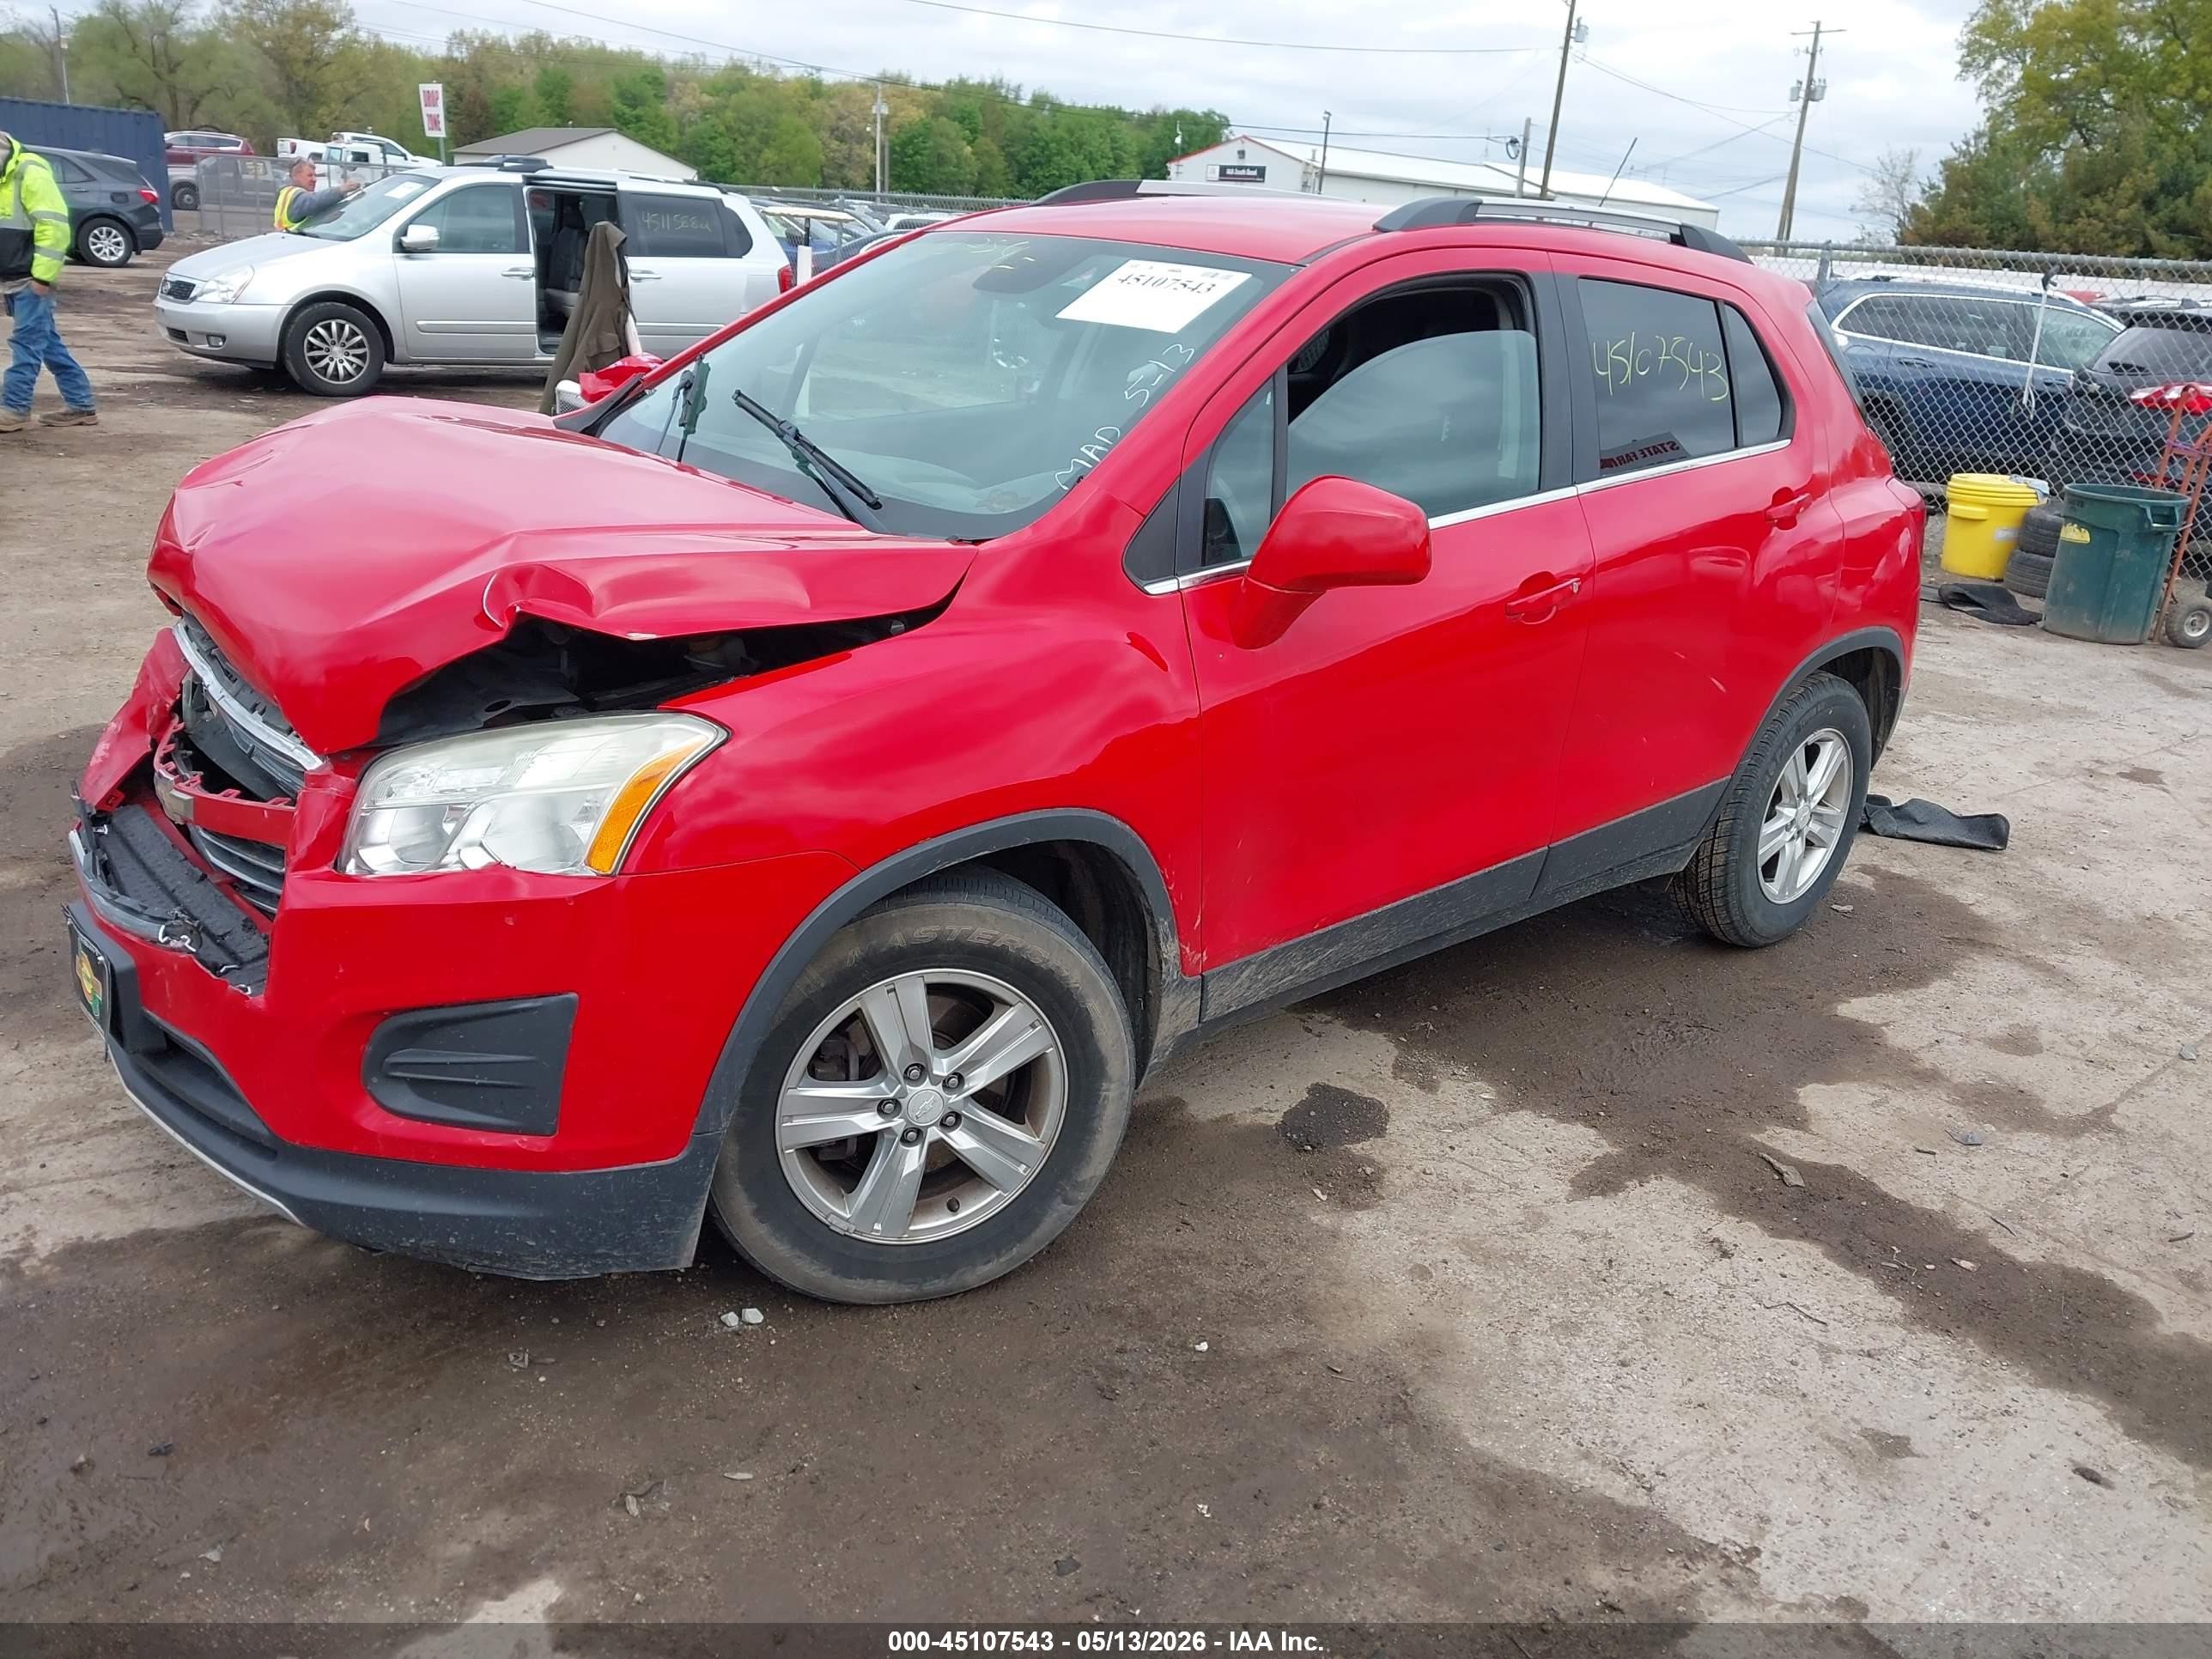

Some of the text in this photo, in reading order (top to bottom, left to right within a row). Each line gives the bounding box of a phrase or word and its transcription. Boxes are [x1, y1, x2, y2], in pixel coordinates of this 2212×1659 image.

[422, 89, 440, 107] DROP
[426, 113, 441, 131] ZONE
[1117, 273, 1217, 295] 45107543
[1054, 343, 1195, 490] MAD 5-13
